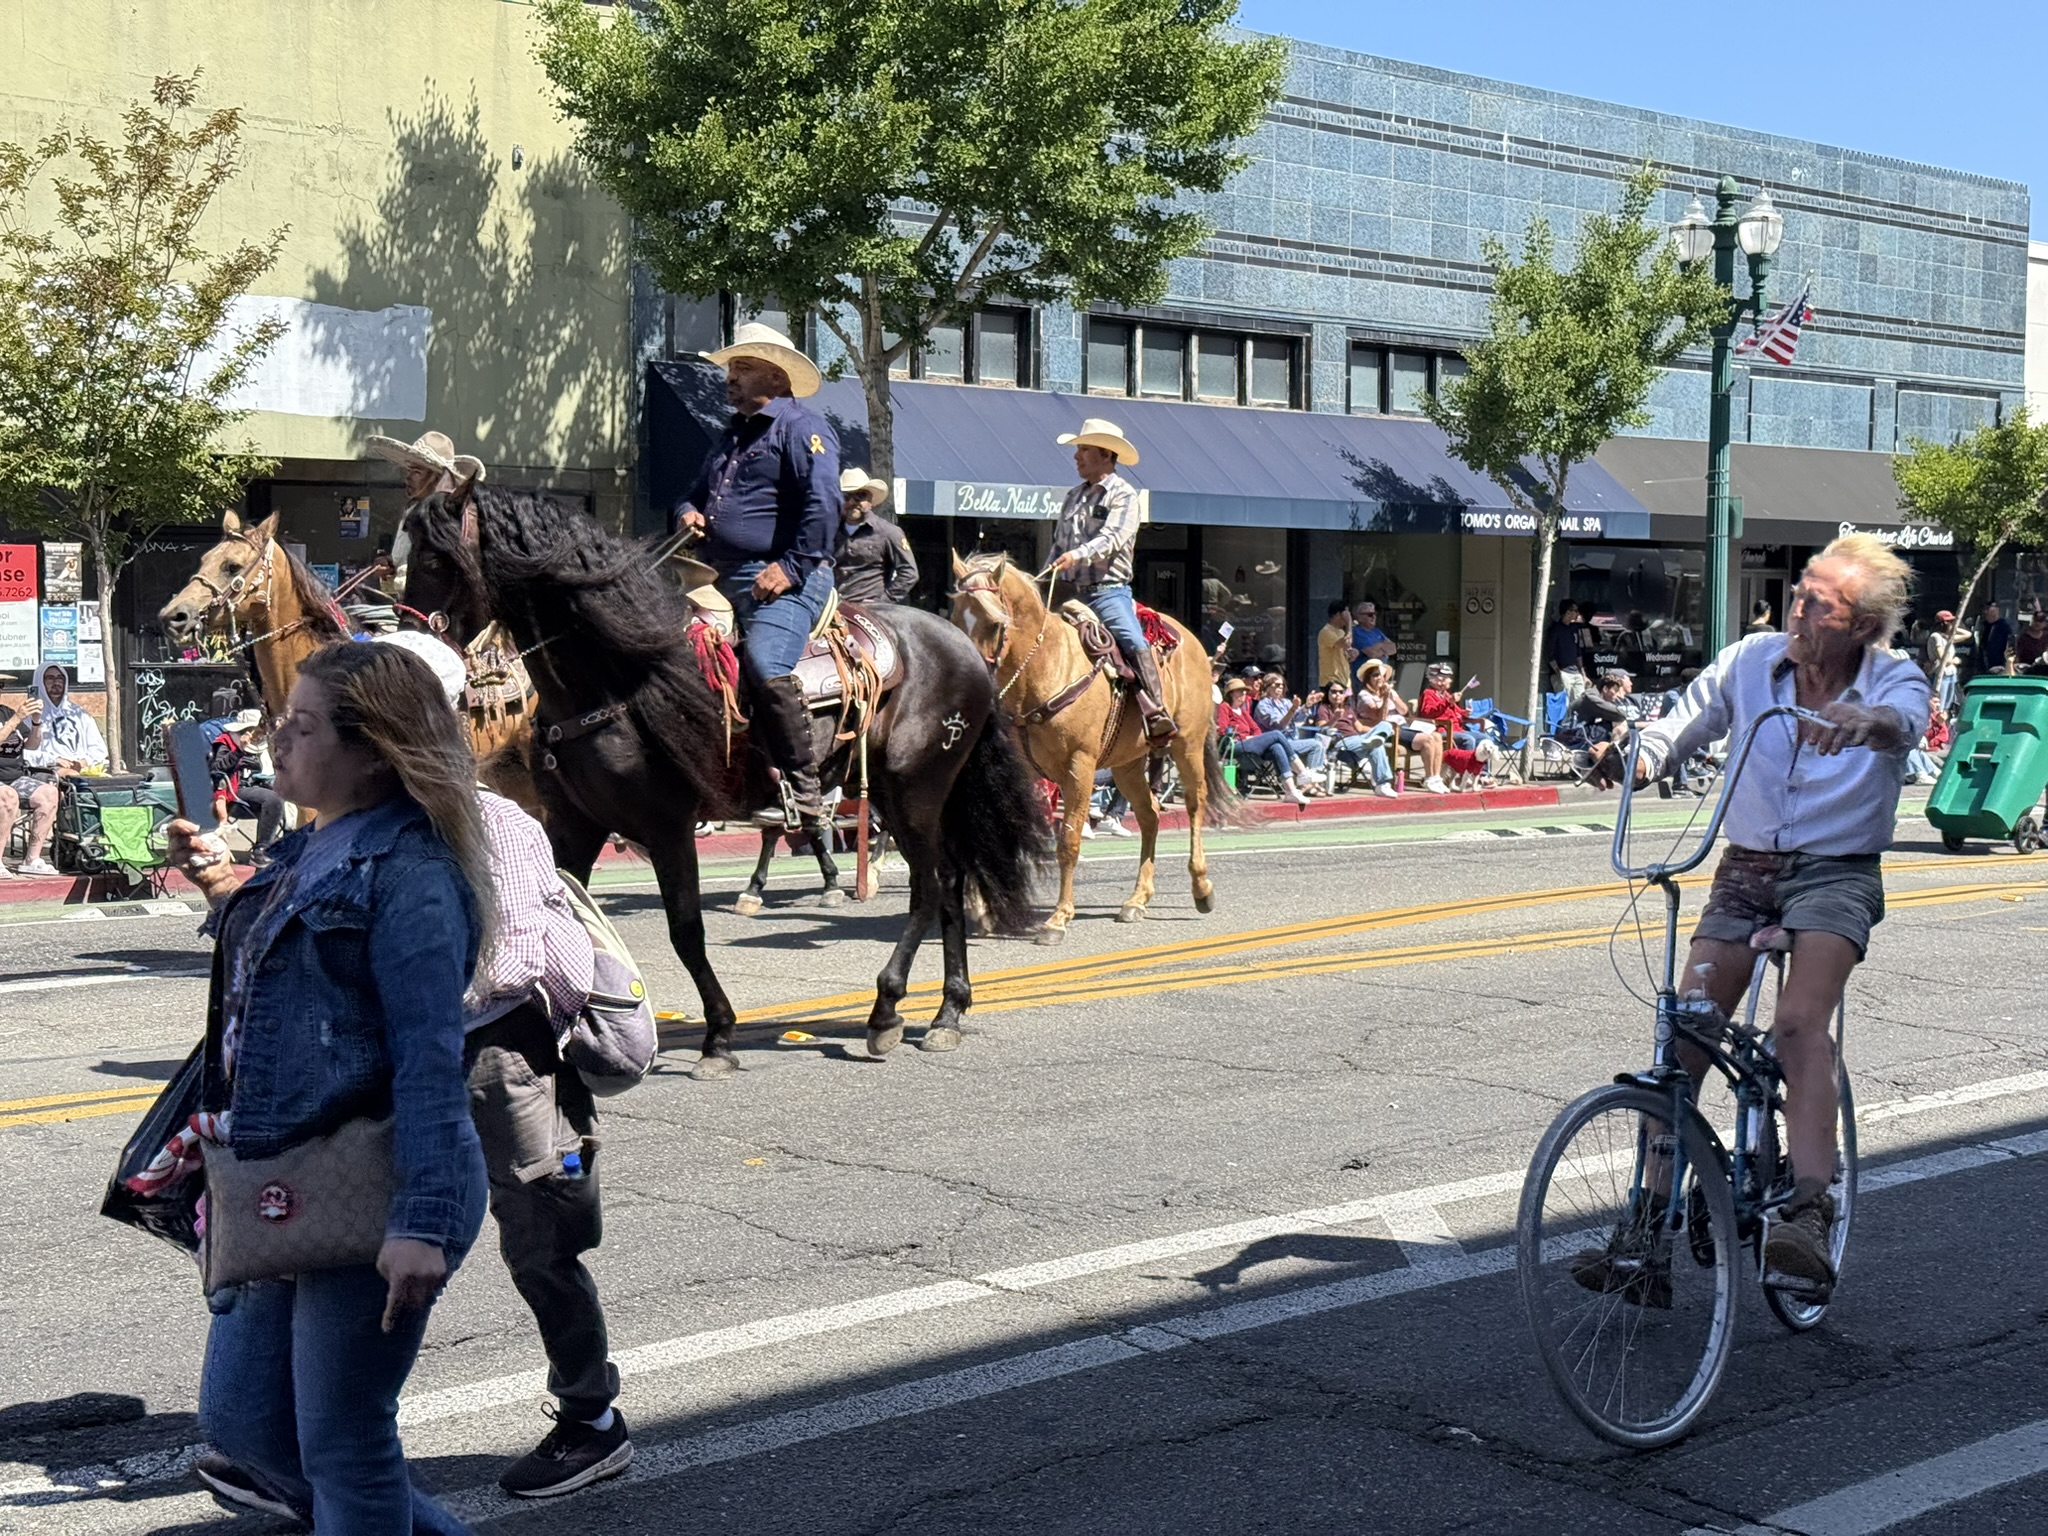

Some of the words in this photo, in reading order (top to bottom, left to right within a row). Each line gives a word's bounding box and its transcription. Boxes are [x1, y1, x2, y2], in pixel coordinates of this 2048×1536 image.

[957, 485, 1001, 512] Bella
[1001, 486, 1037, 514] Nail
[1039, 492, 1063, 519] Spa
[1461, 513, 1501, 528] TOMO'S
[1557, 516, 1580, 531] NAIL
[1582, 516, 1602, 532] SPA
[1896, 525, 1918, 550] Life
[1918, 526, 1953, 546] Church
[1593, 653, 1618, 665] Sunday
[1645, 652, 1681, 663] Wednesday
